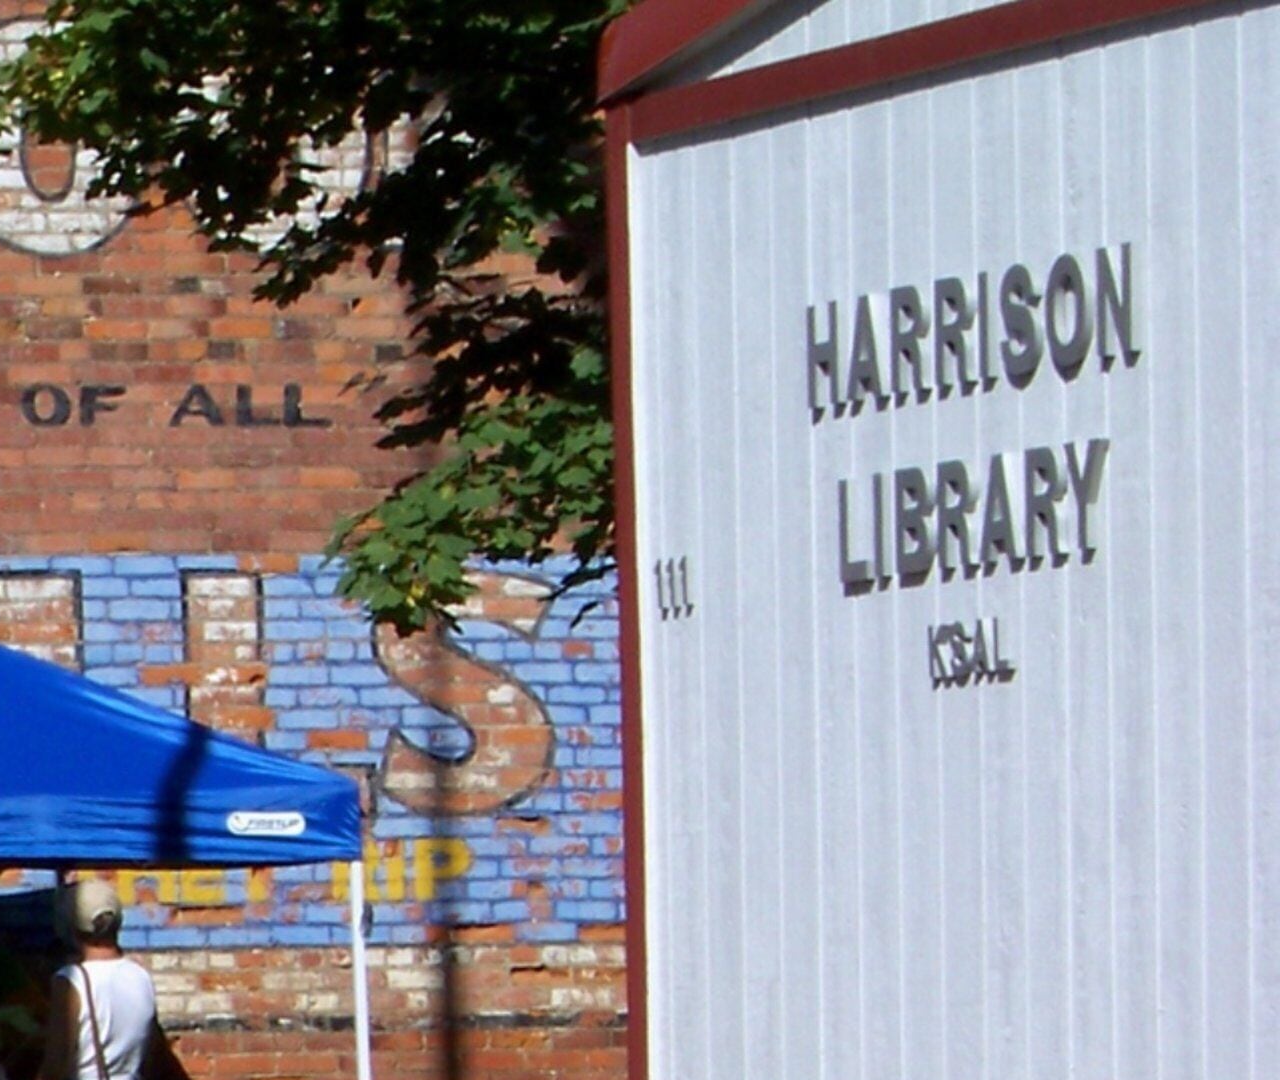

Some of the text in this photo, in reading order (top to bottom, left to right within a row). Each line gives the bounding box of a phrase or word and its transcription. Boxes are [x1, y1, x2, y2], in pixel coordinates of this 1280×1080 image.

[20, 381, 127, 428] OF
[806, 241, 1141, 425] HARRISON
[837, 437, 1111, 598] LIBRARY
